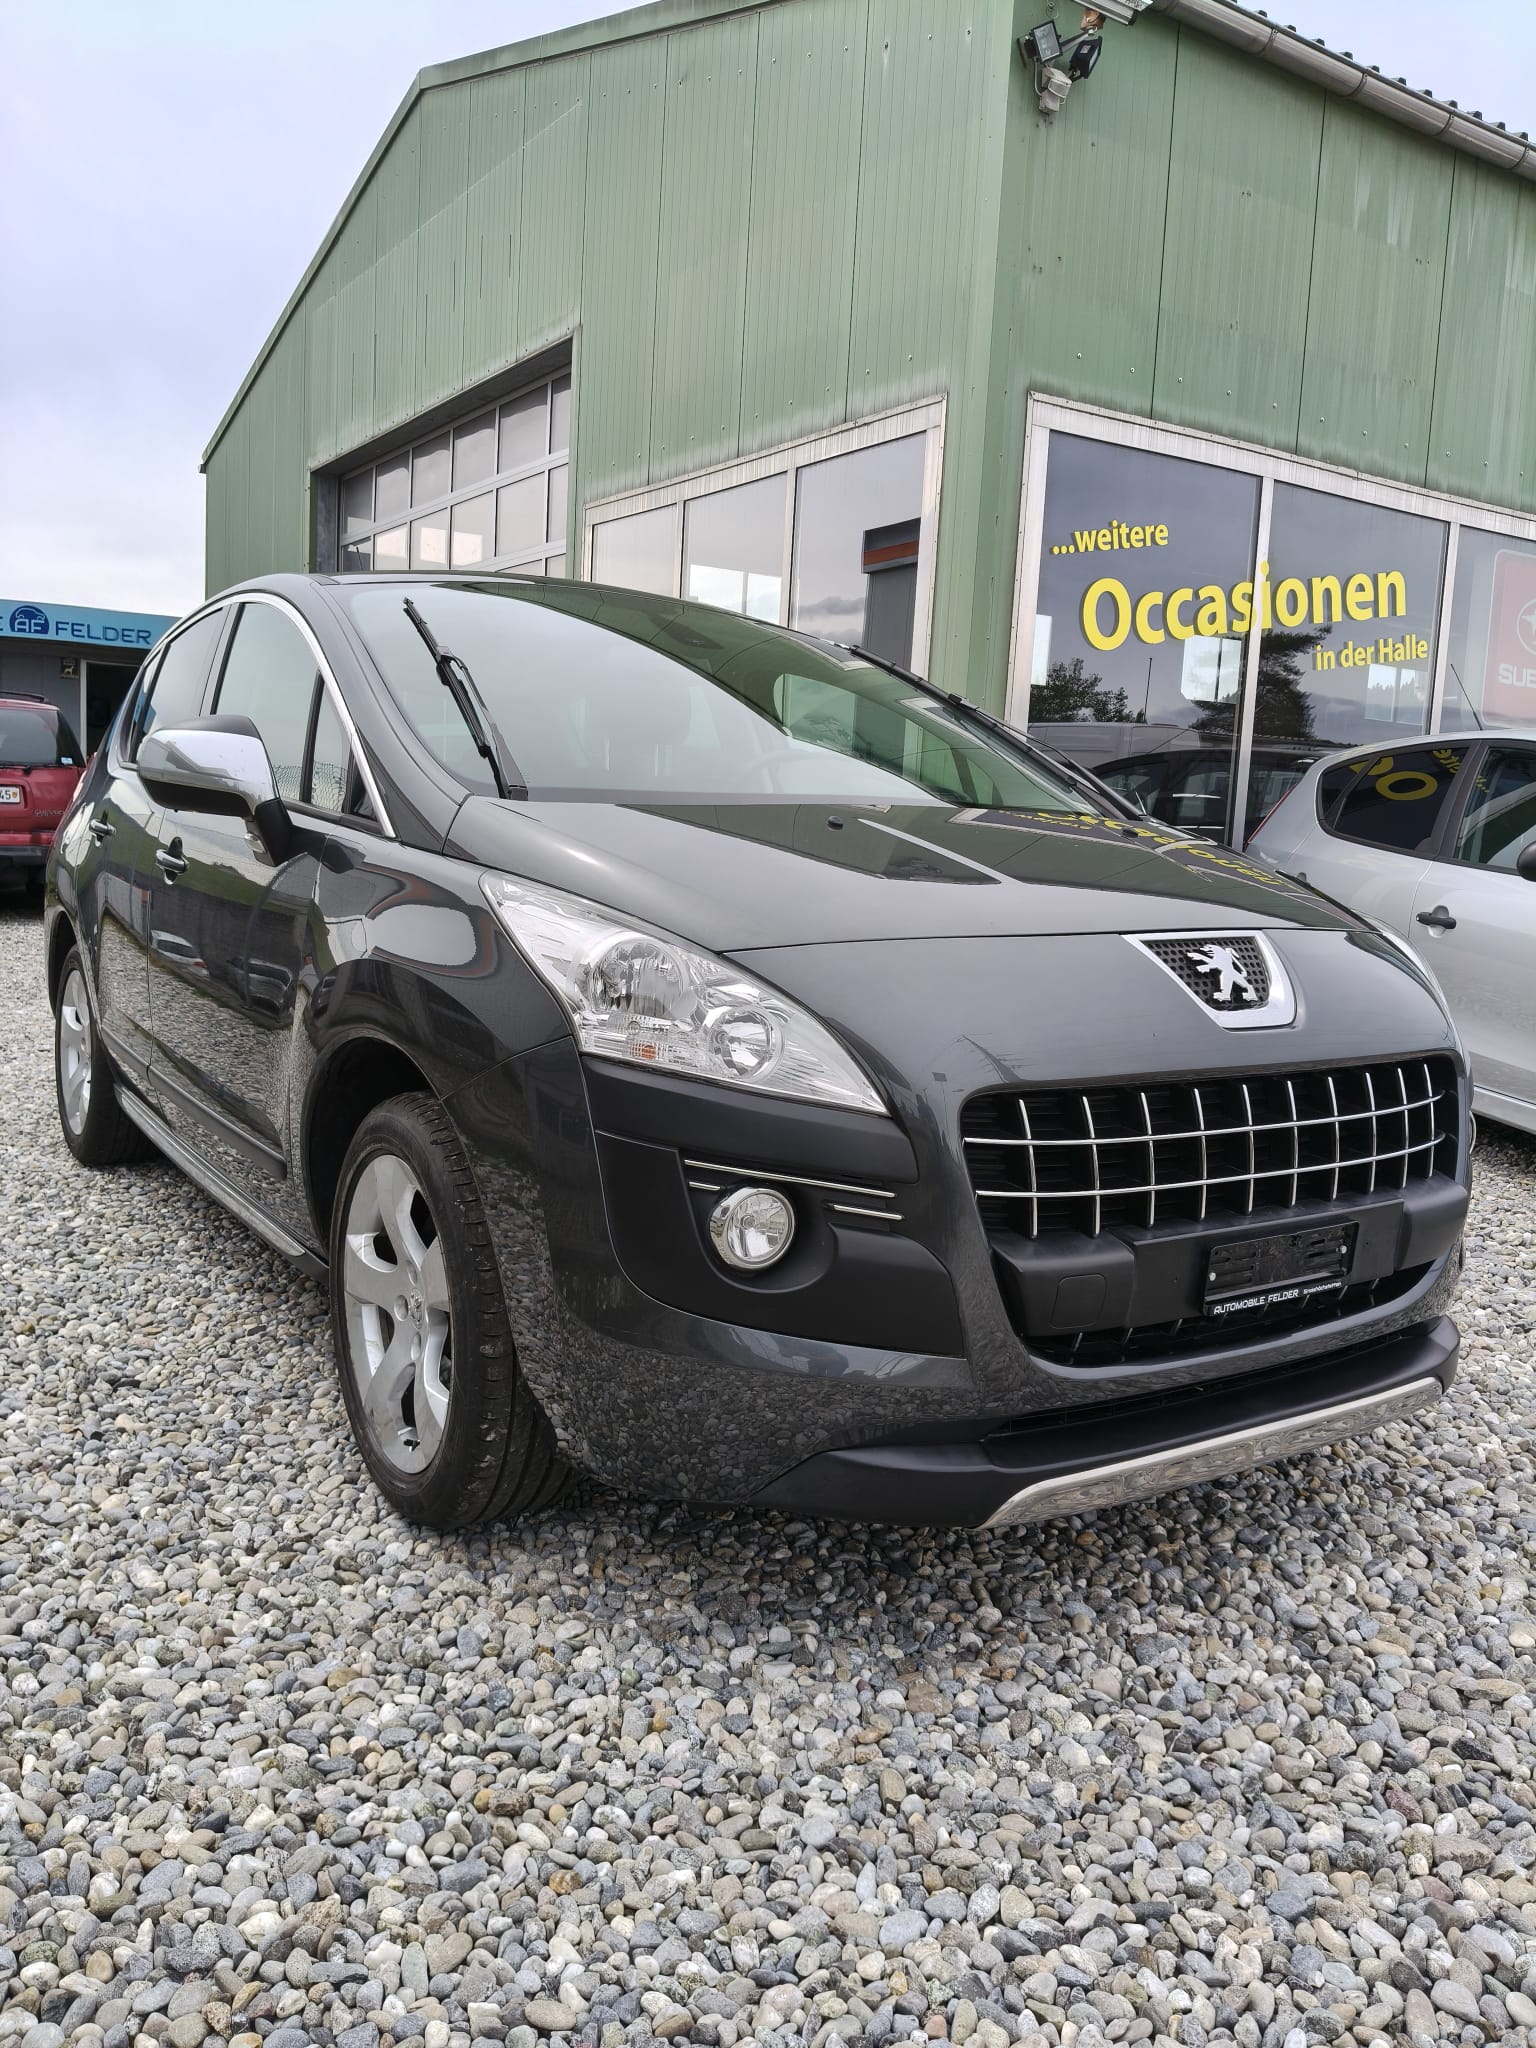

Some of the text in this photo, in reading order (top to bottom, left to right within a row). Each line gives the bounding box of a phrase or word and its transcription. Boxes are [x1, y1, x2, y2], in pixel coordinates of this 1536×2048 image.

[1082, 560, 1406, 651] Occasionen
[55, 621, 152, 645] FELDER
[1315, 634, 1428, 670] in der Halle
[1213, 1289, 1299, 1315] AUTOMOBILE FELDER
